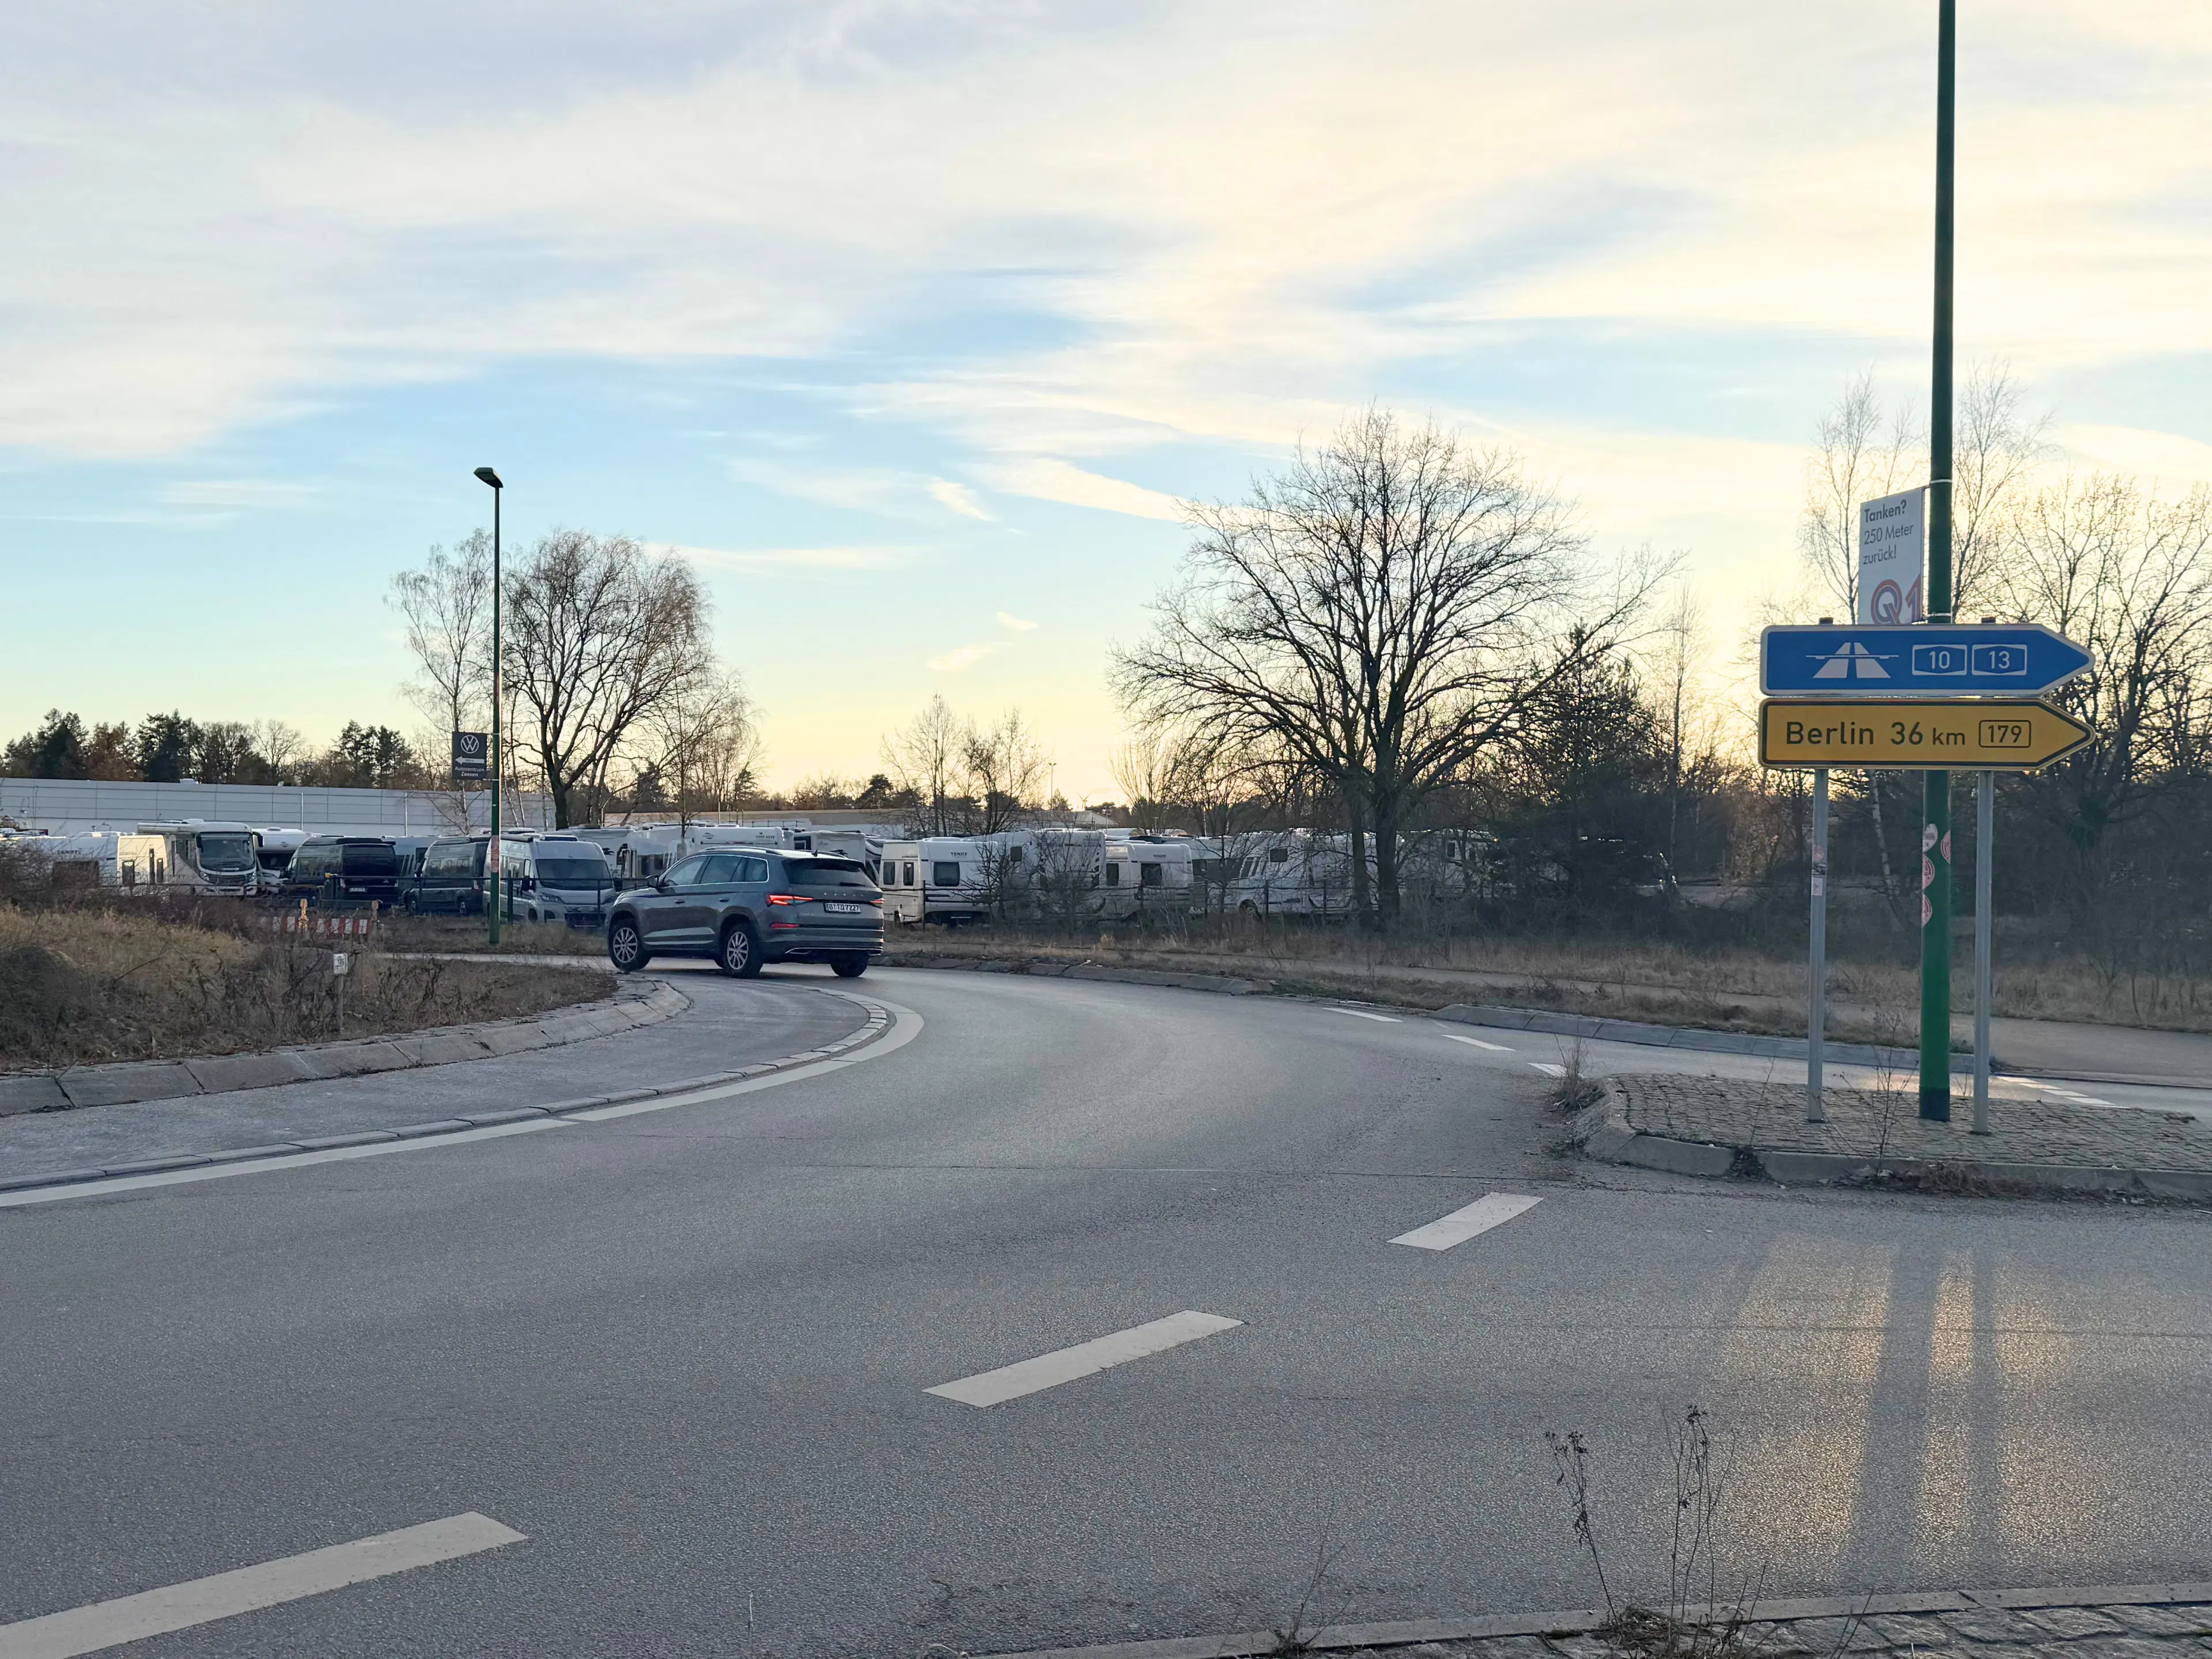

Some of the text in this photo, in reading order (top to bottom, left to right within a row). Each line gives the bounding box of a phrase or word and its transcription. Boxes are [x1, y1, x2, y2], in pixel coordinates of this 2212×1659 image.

[1864, 499, 1907, 523] Tanken?
[1864, 524, 1914, 545] 250 Meter
[1862, 544, 1896, 565] zurück!
[1870, 573, 1921, 626] Q1
[1929, 650, 2010, 669] 10 13
[1786, 721, 2022, 745] Berlin 36 km 179
